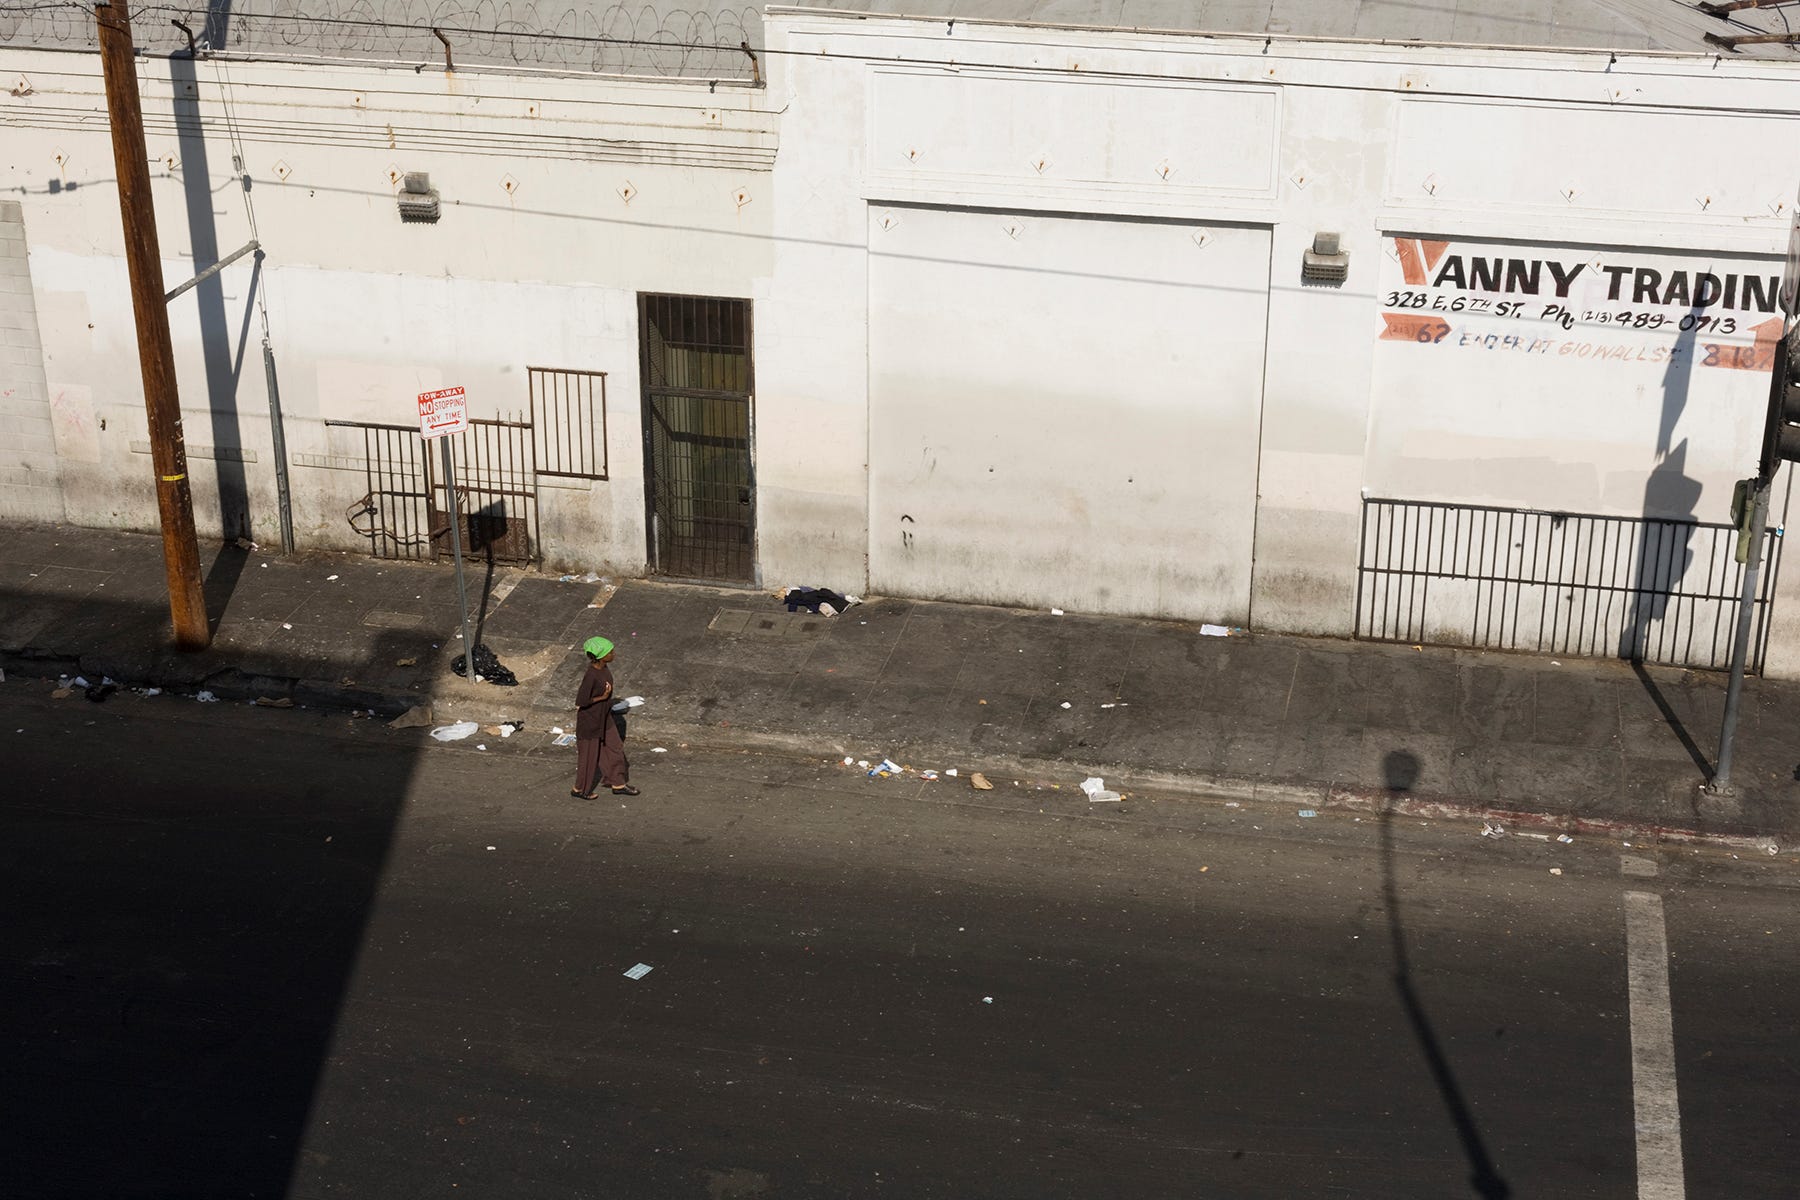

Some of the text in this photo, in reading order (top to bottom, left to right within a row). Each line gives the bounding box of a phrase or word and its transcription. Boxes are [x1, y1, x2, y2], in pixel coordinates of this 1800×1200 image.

[1394, 237, 1587, 298] VANNY
[1384, 291, 1428, 309] 328
[1494, 300, 1526, 319] ST.
[1540, 304, 1575, 330] Ph.
[1580, 311, 1612, 323] (213)
[1615, 311, 1737, 334] 489-0713
[419, 387, 463, 400] TOW-AWAY
[420, 397, 464, 415] NO STOPPING
[427, 410, 462, 424] ANY TIME
